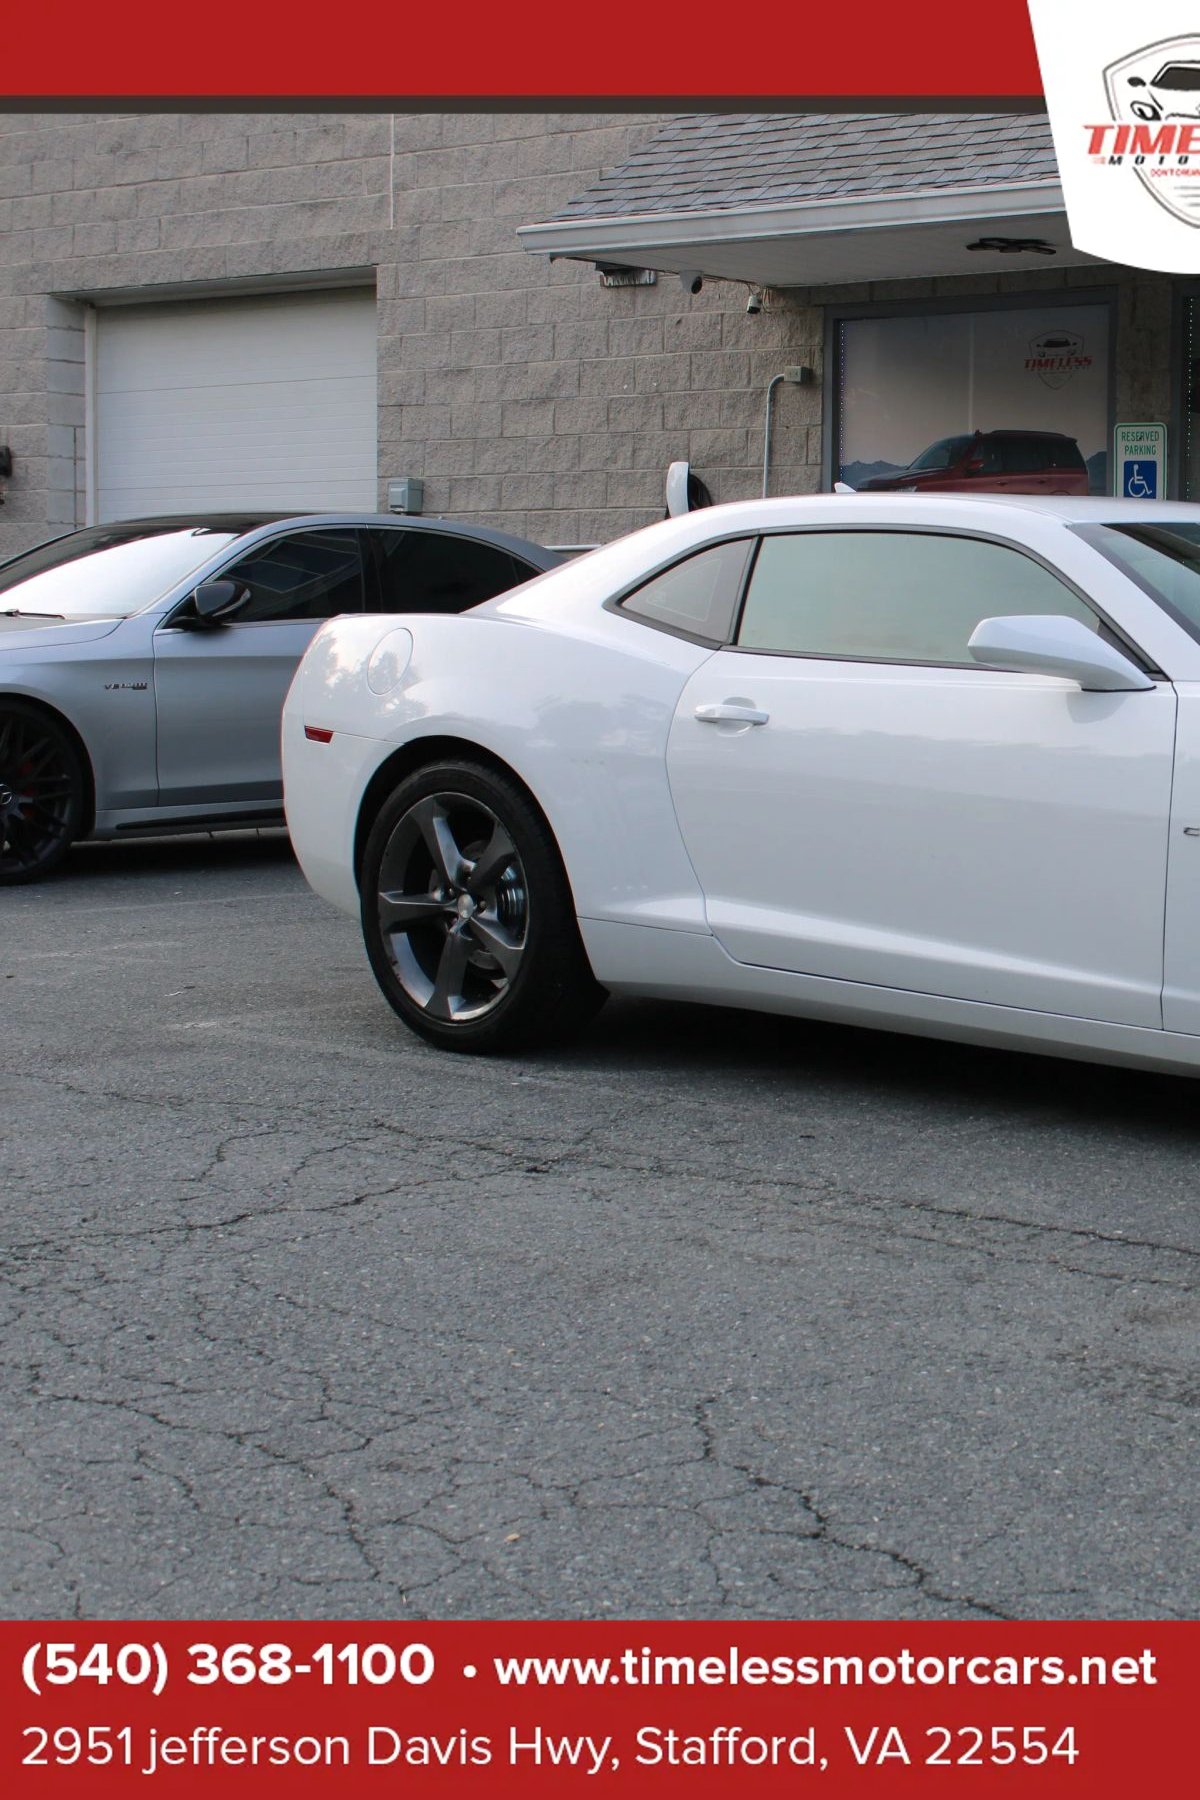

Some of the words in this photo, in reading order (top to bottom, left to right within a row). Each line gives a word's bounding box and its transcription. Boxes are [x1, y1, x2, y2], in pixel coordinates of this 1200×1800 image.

[1024, 355, 1094, 369] TIMELESS
[1121, 430, 1160, 442] RESERVED
[1124, 445, 1157, 456] PARKING
